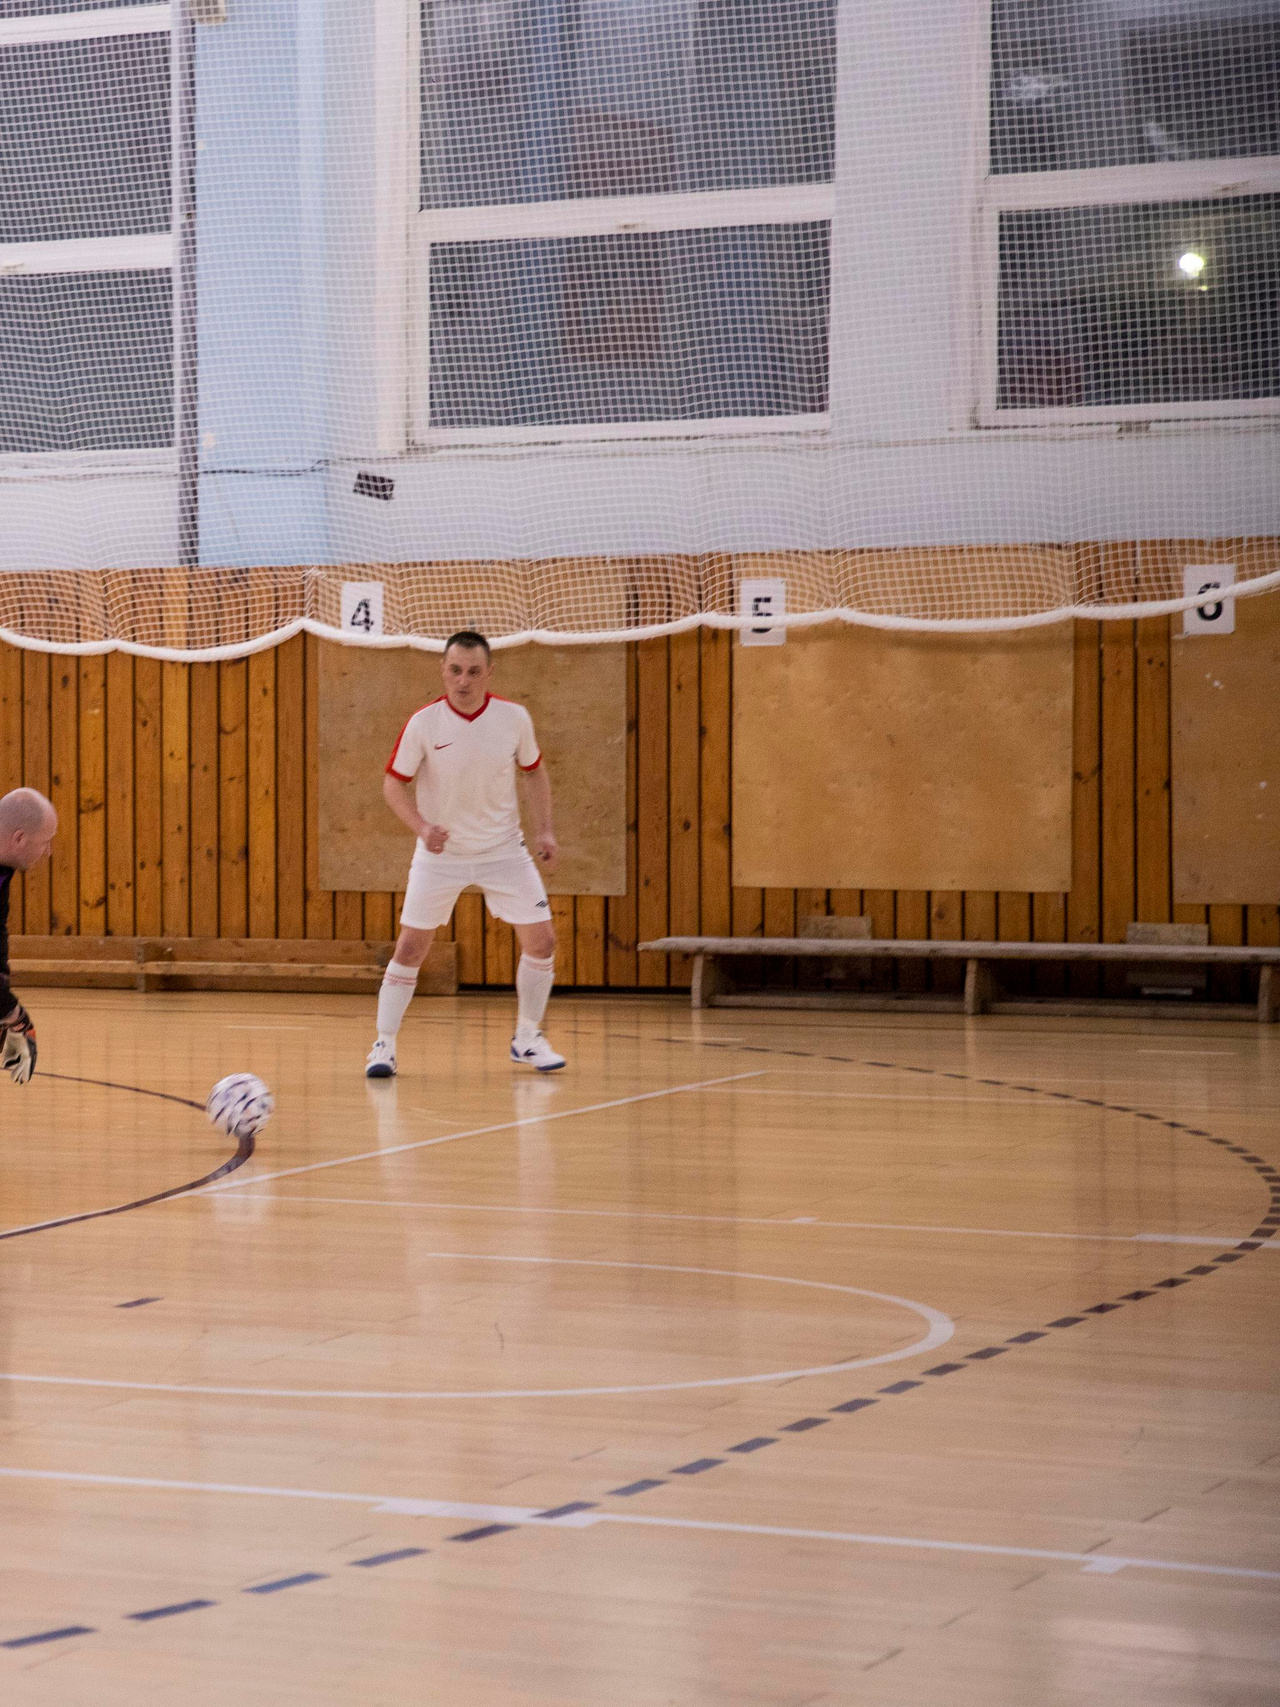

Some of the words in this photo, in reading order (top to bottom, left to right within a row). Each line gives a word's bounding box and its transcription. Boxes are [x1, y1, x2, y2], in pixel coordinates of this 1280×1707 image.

[350, 599, 374, 633] 4
[751, 597, 773, 634] 5
[1197, 582, 1223, 621] 6
